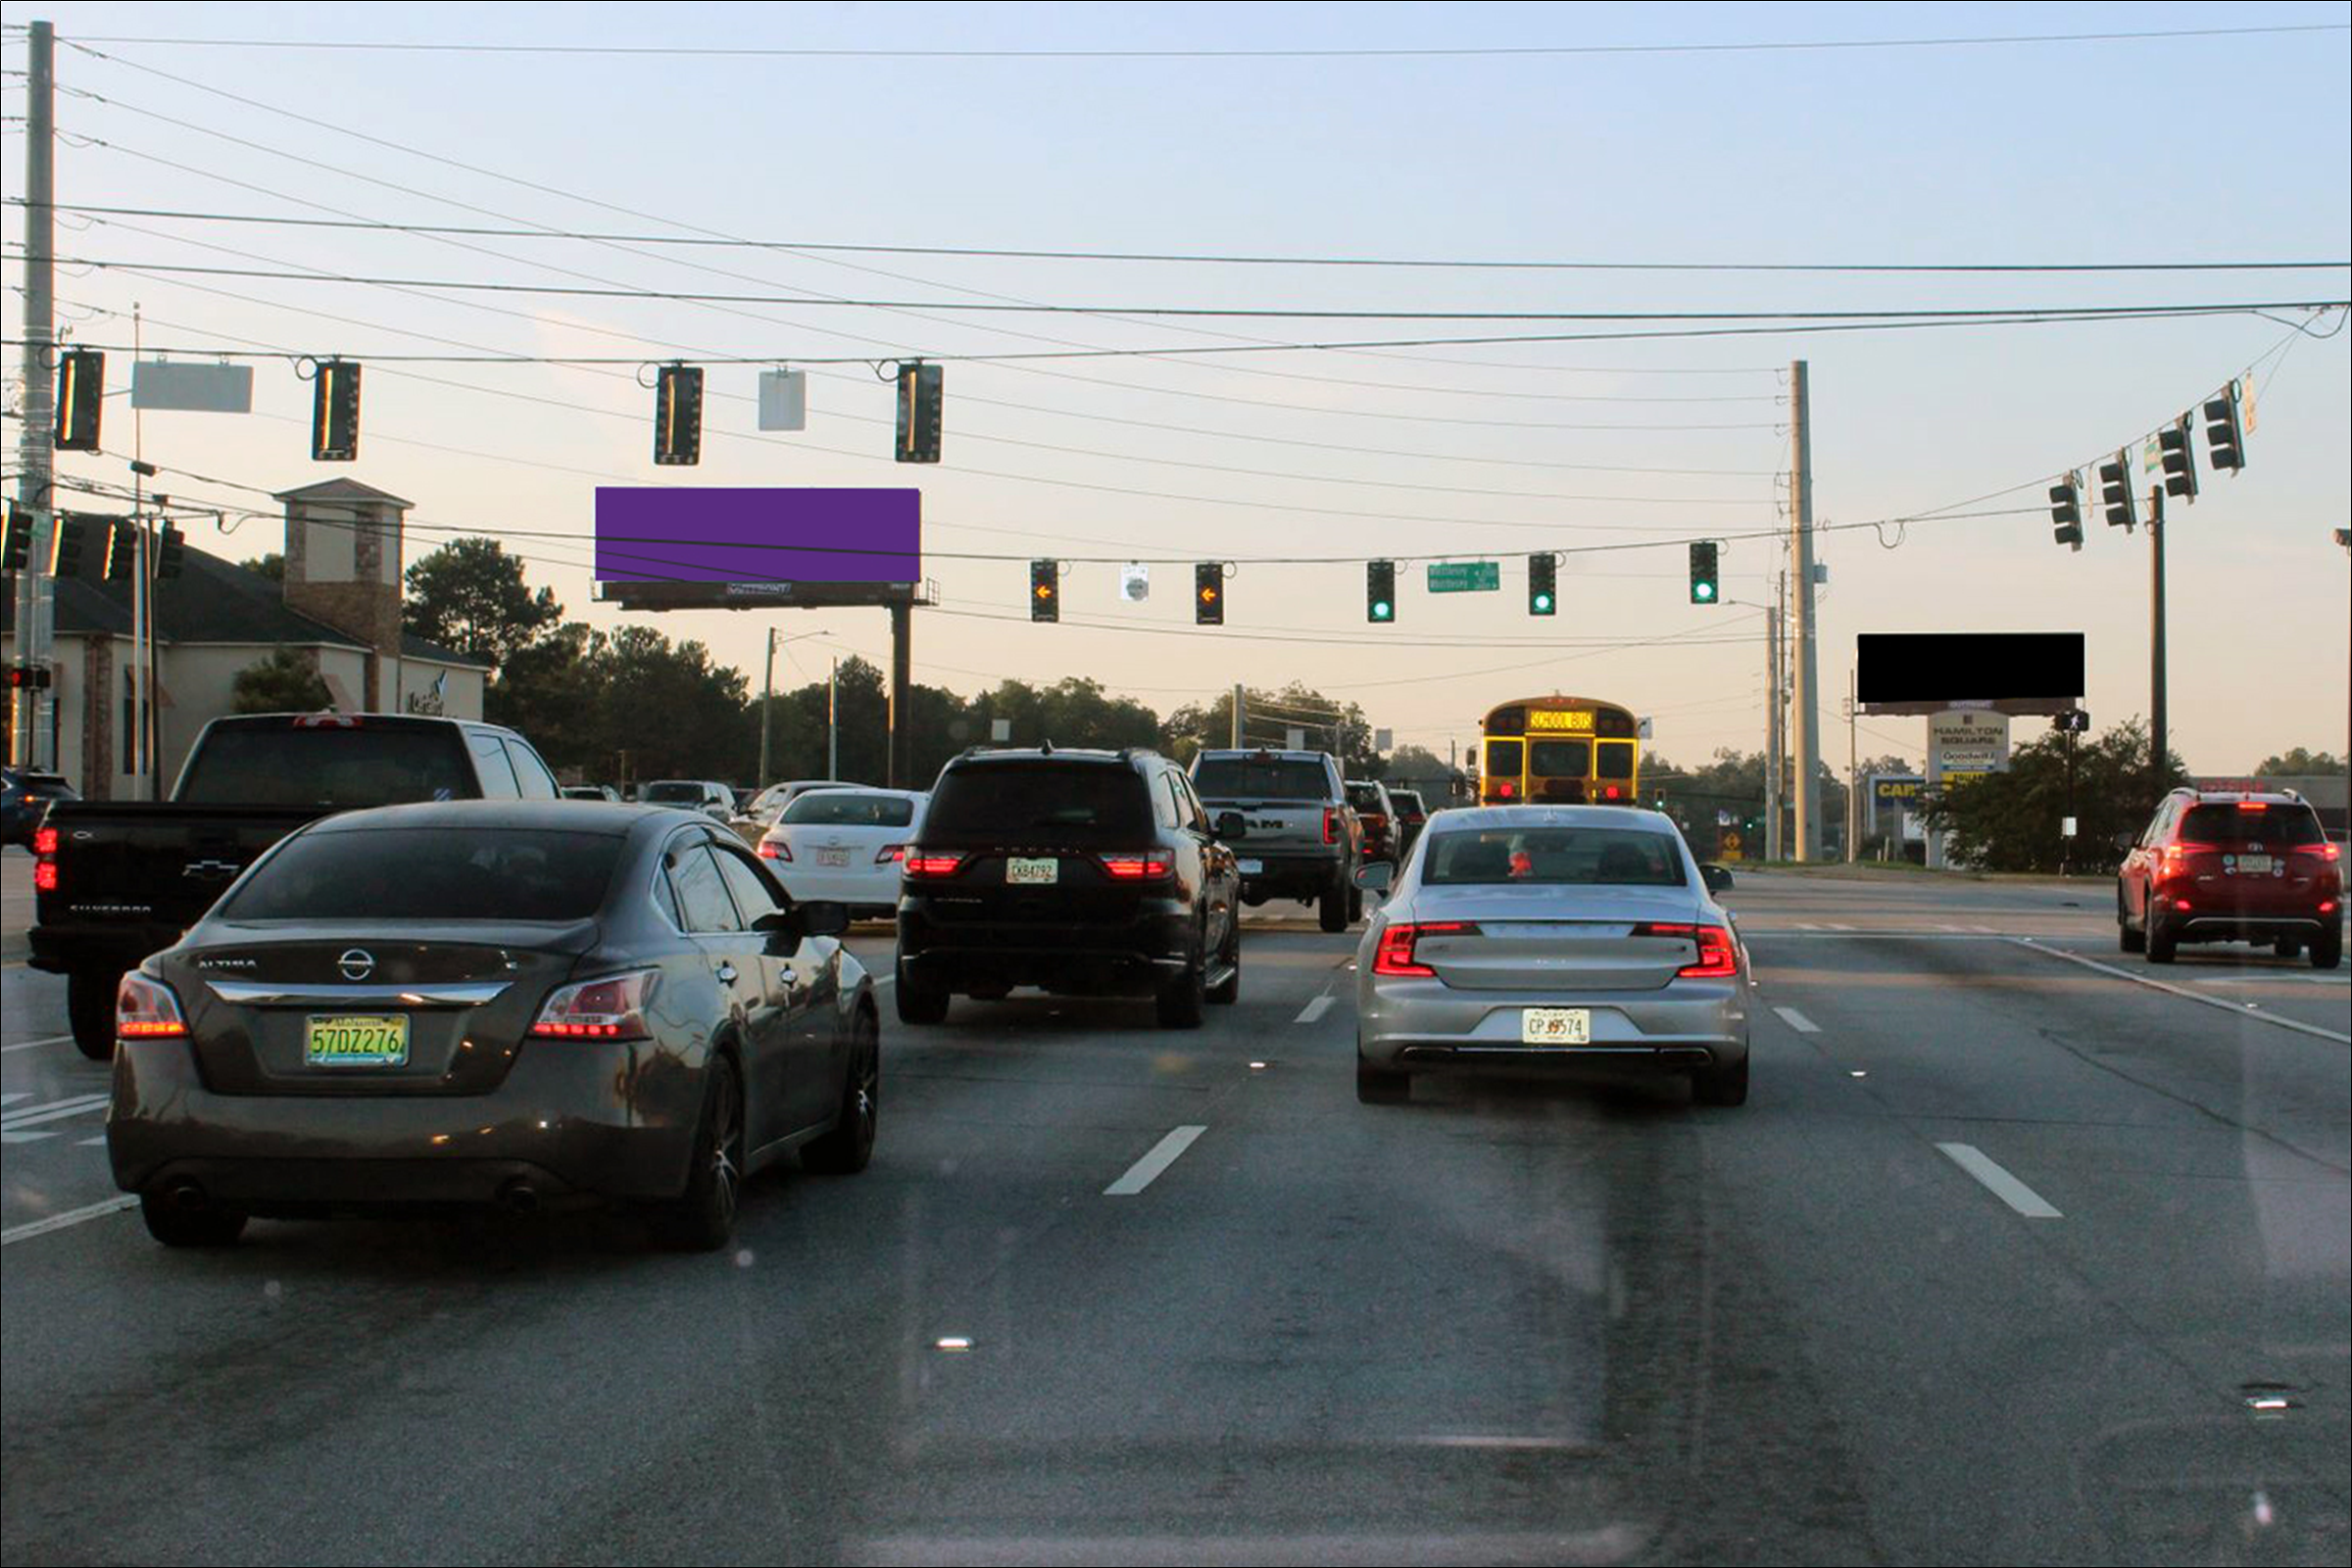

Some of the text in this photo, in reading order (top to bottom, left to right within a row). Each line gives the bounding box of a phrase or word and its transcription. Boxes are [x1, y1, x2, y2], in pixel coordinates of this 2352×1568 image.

[1531, 711, 1592, 729] SCHOOL BUS
[1934, 726, 2003, 736] HAMILTON
[1942, 751, 1995, 760] Goodwill
[1245, 819, 1284, 829] AM
[198, 959, 258, 969] ALTIMA
